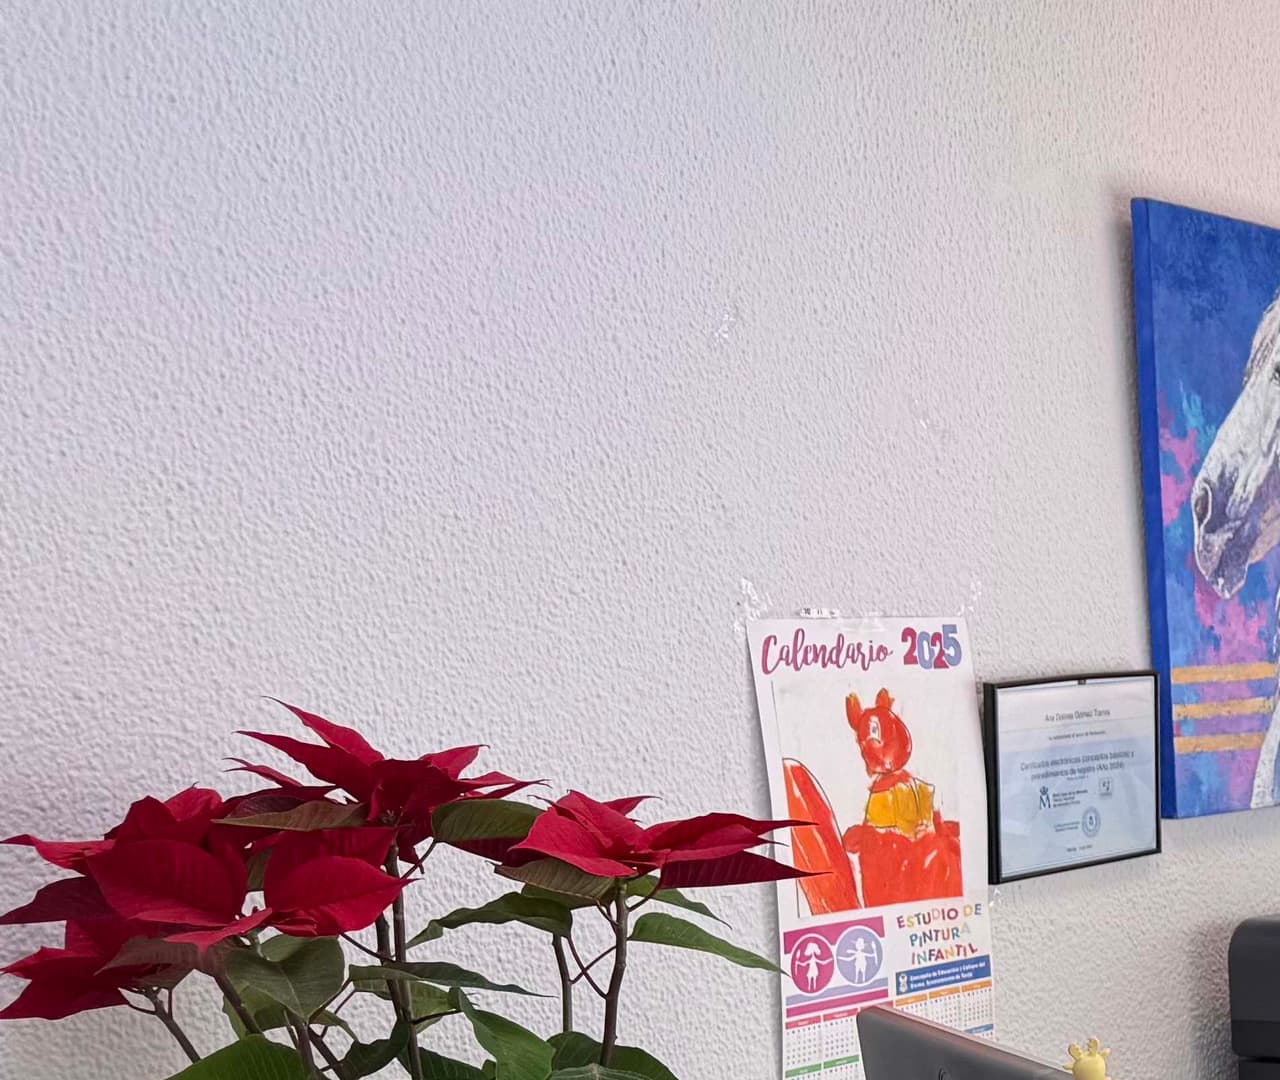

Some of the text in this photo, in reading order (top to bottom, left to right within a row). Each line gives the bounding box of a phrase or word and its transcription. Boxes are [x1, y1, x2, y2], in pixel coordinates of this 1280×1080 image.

[761, 624, 962, 675] Calendario 2025
[896, 903, 982, 929] ESTUDIO DE
[909, 922, 971, 947] PINTURA
[911, 943, 978, 965] INFANTIL
